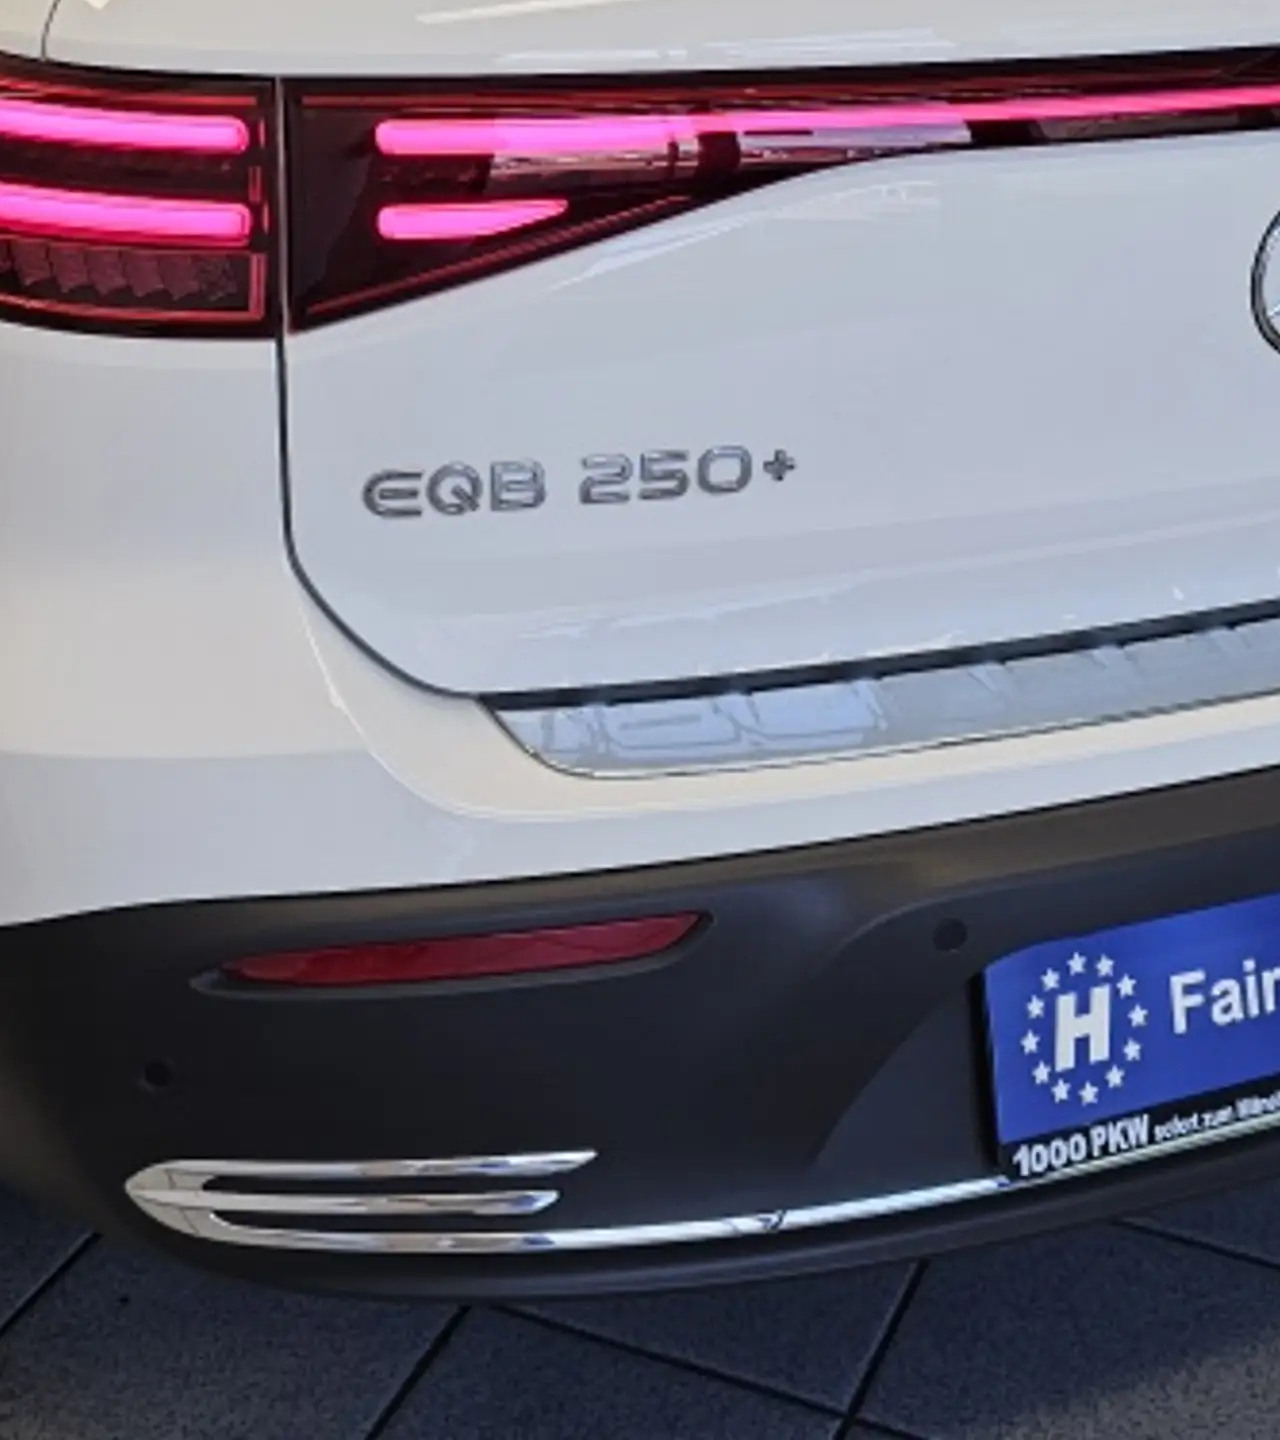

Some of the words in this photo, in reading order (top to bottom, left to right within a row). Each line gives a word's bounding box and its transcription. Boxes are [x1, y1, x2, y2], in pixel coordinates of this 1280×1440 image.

[361, 459, 547, 519] EQB
[577, 445, 797, 505] 250+
[1053, 984, 1111, 1072] H
[1012, 1132, 1087, 1177] 1000
[1089, 1113, 1150, 1157] PKW
